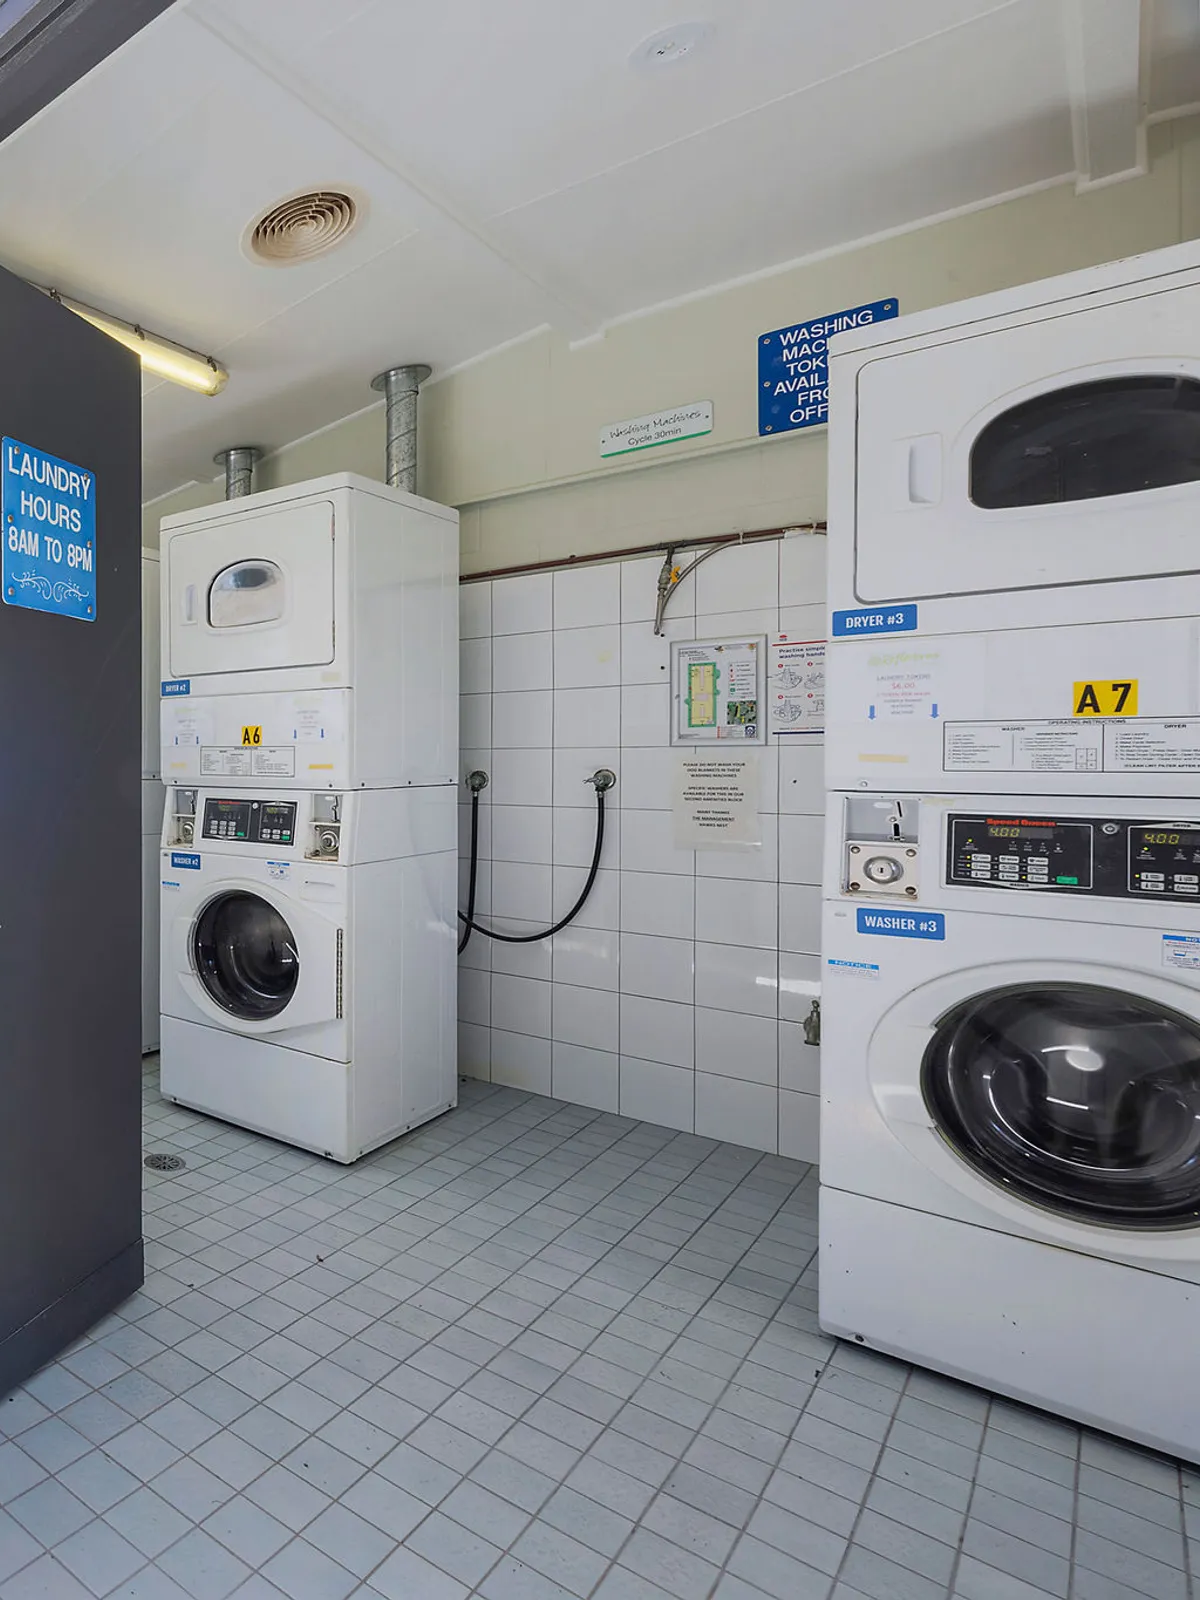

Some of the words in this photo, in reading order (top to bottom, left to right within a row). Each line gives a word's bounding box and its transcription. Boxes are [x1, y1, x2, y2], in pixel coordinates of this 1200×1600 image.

[780, 310, 873, 346] WASHING
[783, 338, 829, 362] MAC
[610, 424, 650, 439] Washing
[653, 411, 701, 428] Machines
[628, 435, 652, 446] Cycle
[655, 428, 681, 440] 30min
[9, 447, 90, 500] LAUNDRY
[21, 490, 81, 532] HOURS
[9, 526, 39, 557] 8AM
[44, 536, 62, 563] TO
[68, 544, 92, 572] 8PM
[846, 615, 883, 628] DRYER
[888, 613, 904, 624] #3
[986, 818, 1019, 826] Speed
[1021, 819, 1056, 827] Queen
[865, 916, 916, 930] WASHER
[920, 921, 936, 932] #3
